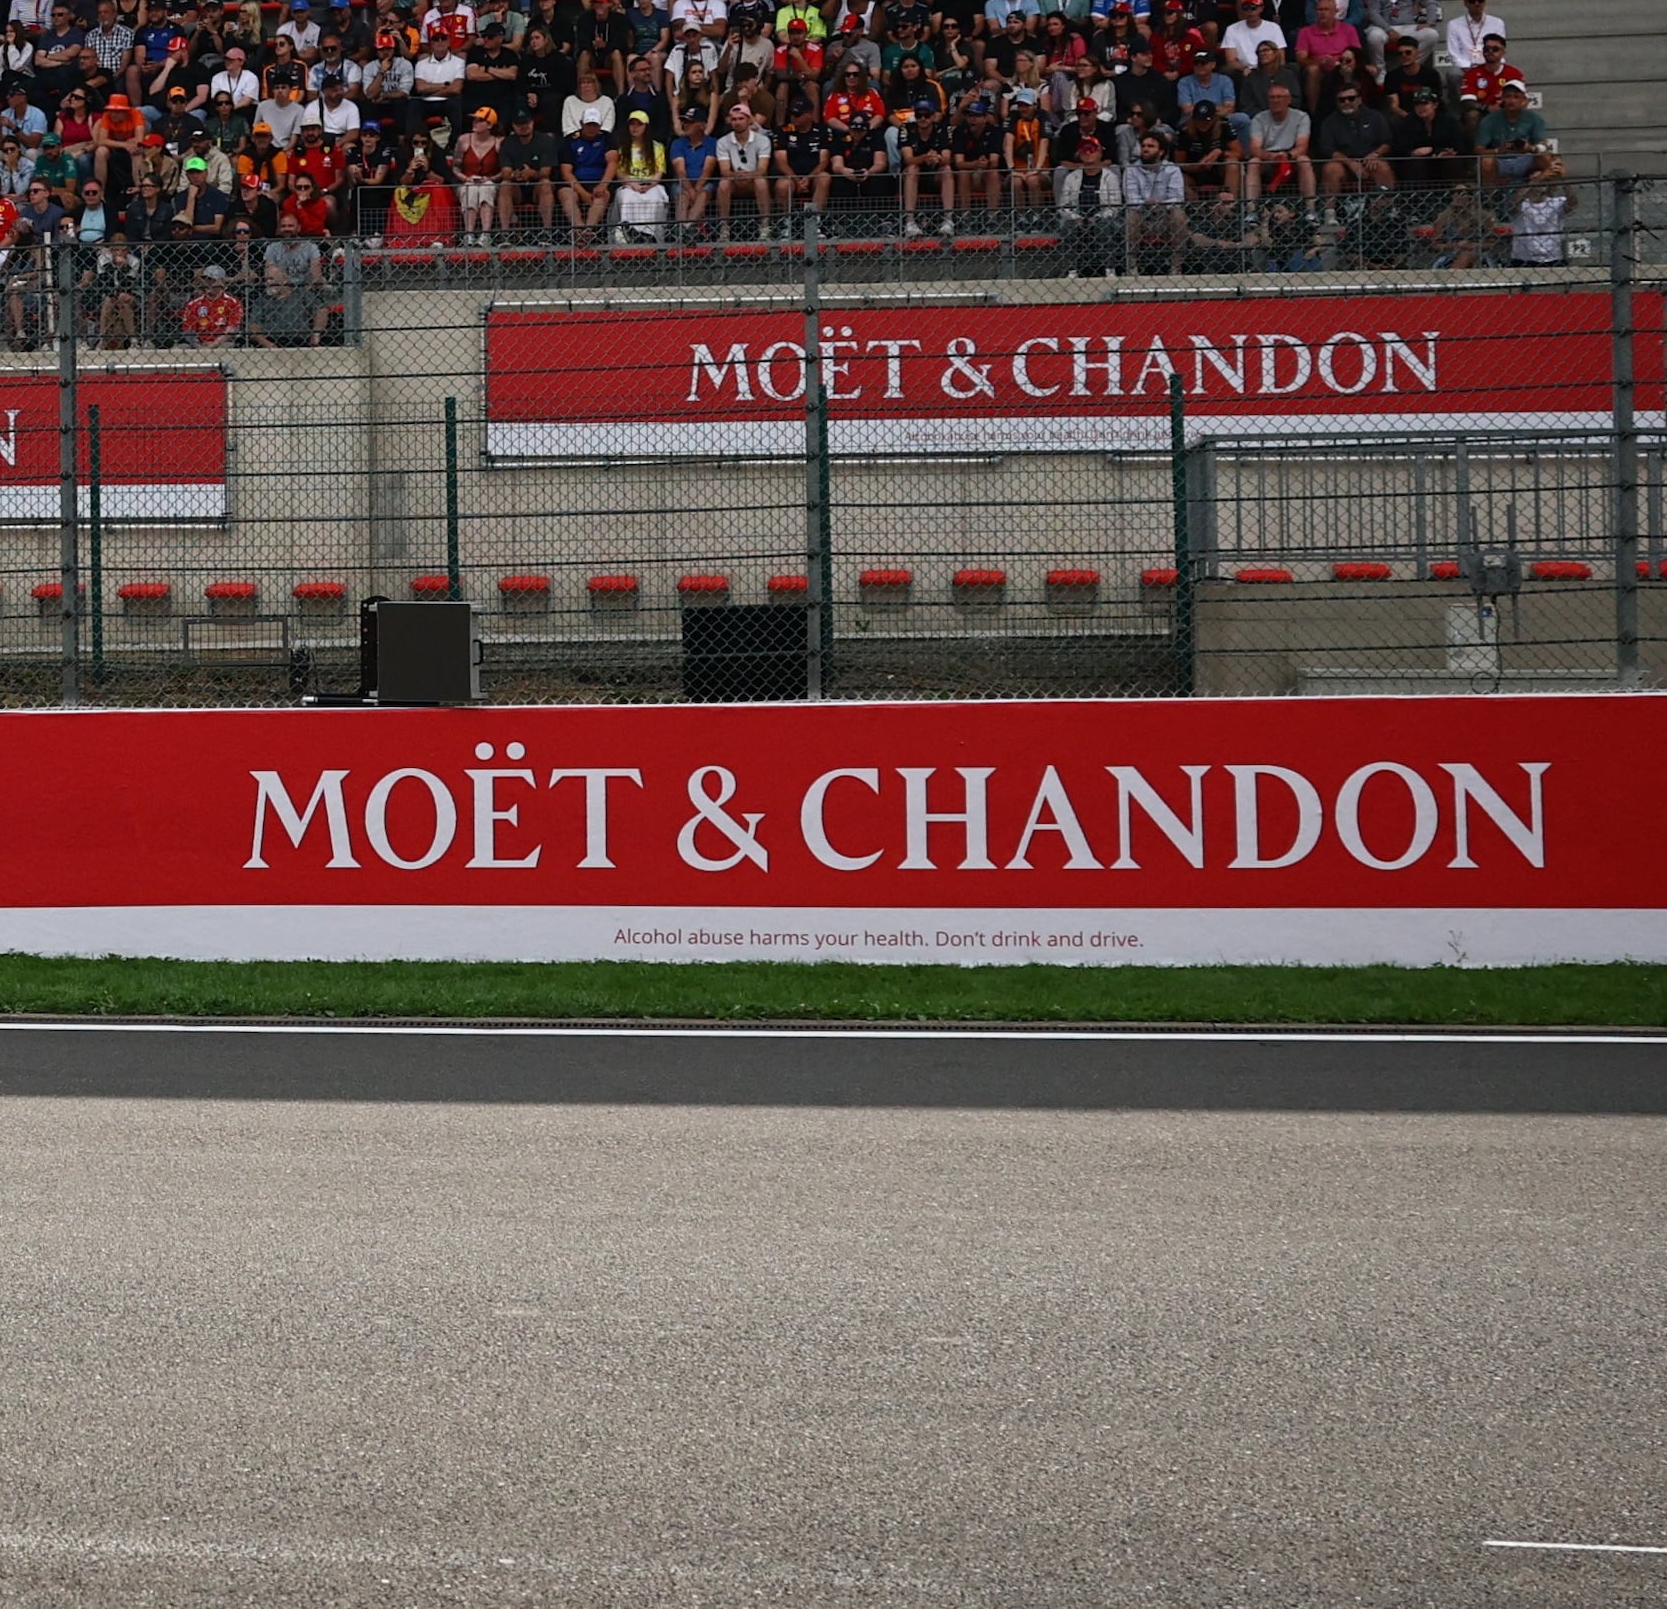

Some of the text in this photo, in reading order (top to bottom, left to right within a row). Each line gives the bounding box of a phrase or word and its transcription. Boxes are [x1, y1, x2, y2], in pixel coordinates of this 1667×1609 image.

[687, 326, 1442, 402] MOËT & CHANDON
[243, 742, 1552, 873] MOËT & CHANDON
[614, 927, 1144, 951] Alcohol abuse harms your health. Don't drink and drive.
